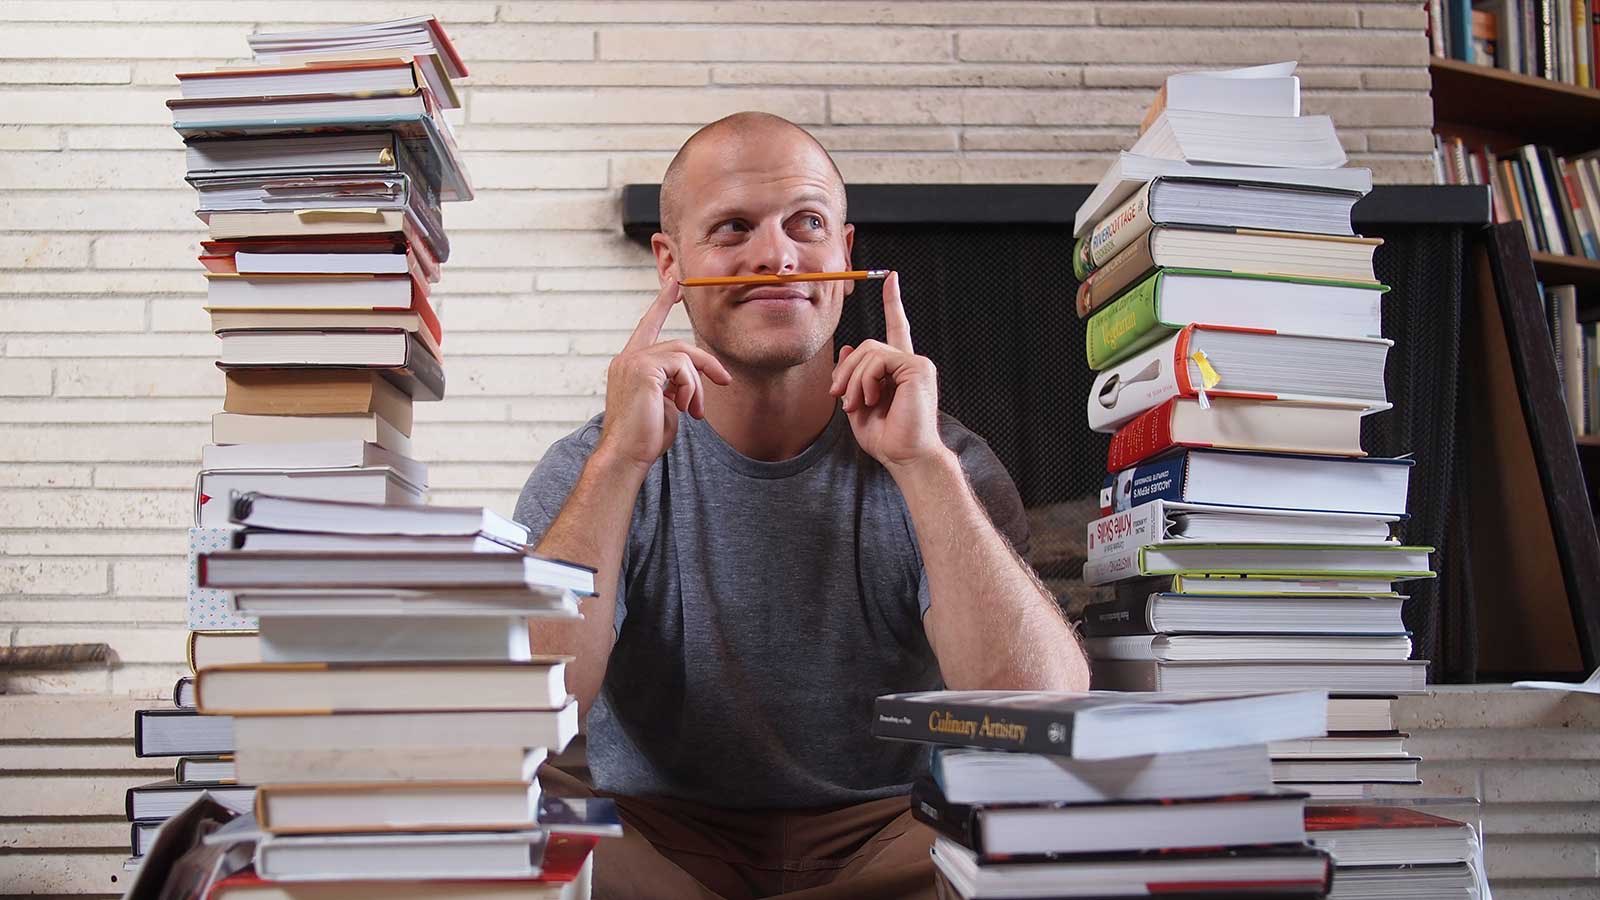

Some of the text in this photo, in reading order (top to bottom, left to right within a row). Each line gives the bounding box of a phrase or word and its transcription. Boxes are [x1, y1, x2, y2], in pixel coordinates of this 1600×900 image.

[1150, 479, 1172, 493] JACQUES
[1097, 520, 1114, 545] Skills
[1114, 514, 1132, 537] Knife
[928, 711, 976, 739] Culinary
[978, 715, 1027, 742] Artistry
